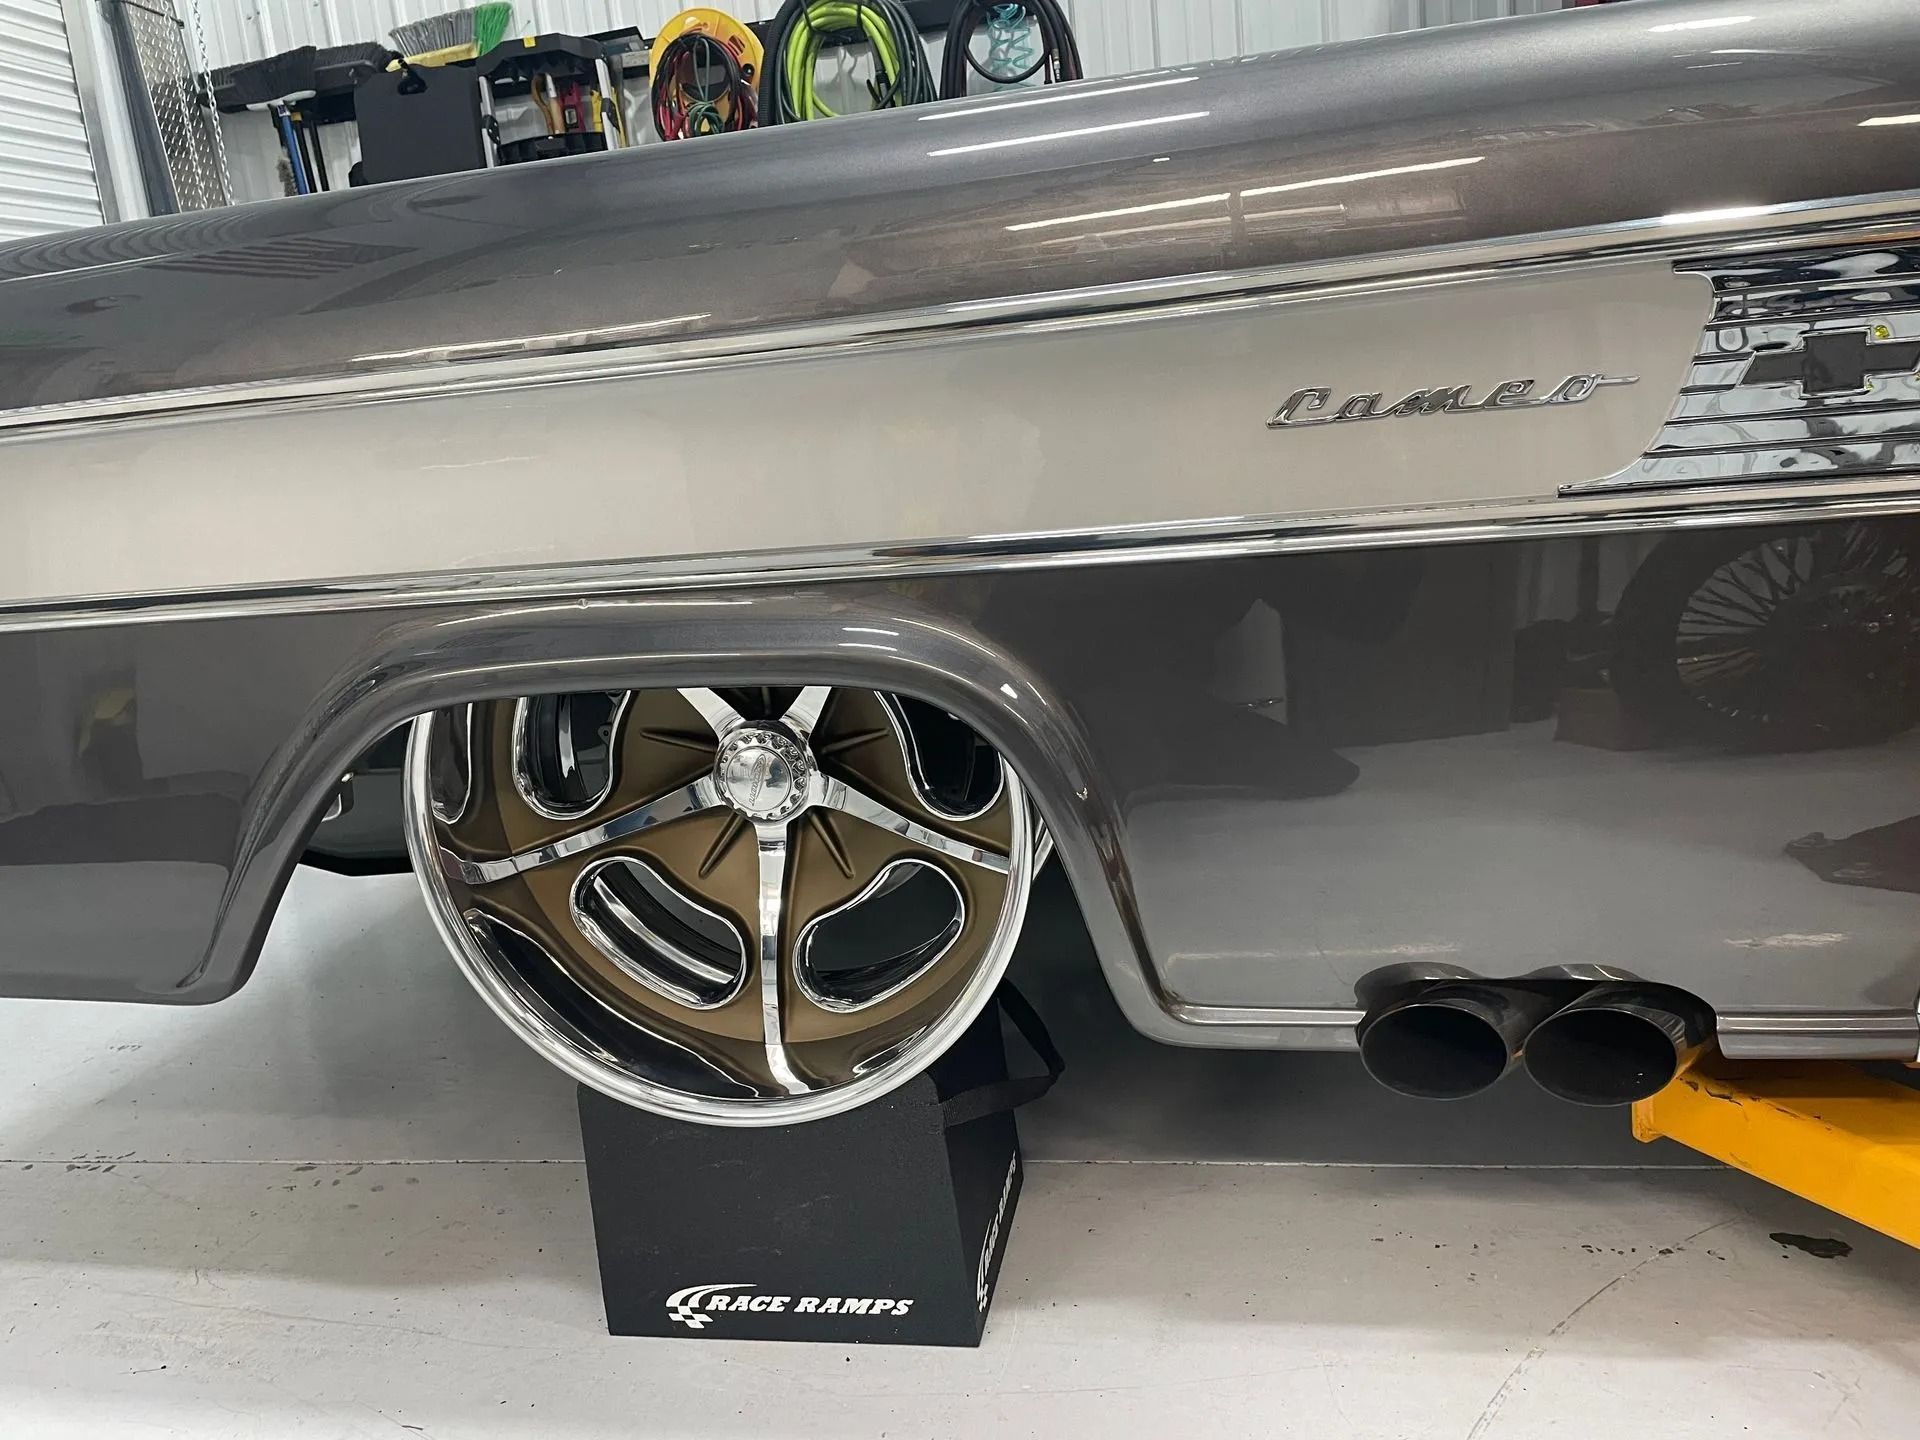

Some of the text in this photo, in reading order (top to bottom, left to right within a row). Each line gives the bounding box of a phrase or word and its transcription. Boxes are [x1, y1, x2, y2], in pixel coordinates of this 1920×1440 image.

[1266, 374, 1640, 429] Cameo
[705, 1294, 914, 1316] RACE RAMPS
